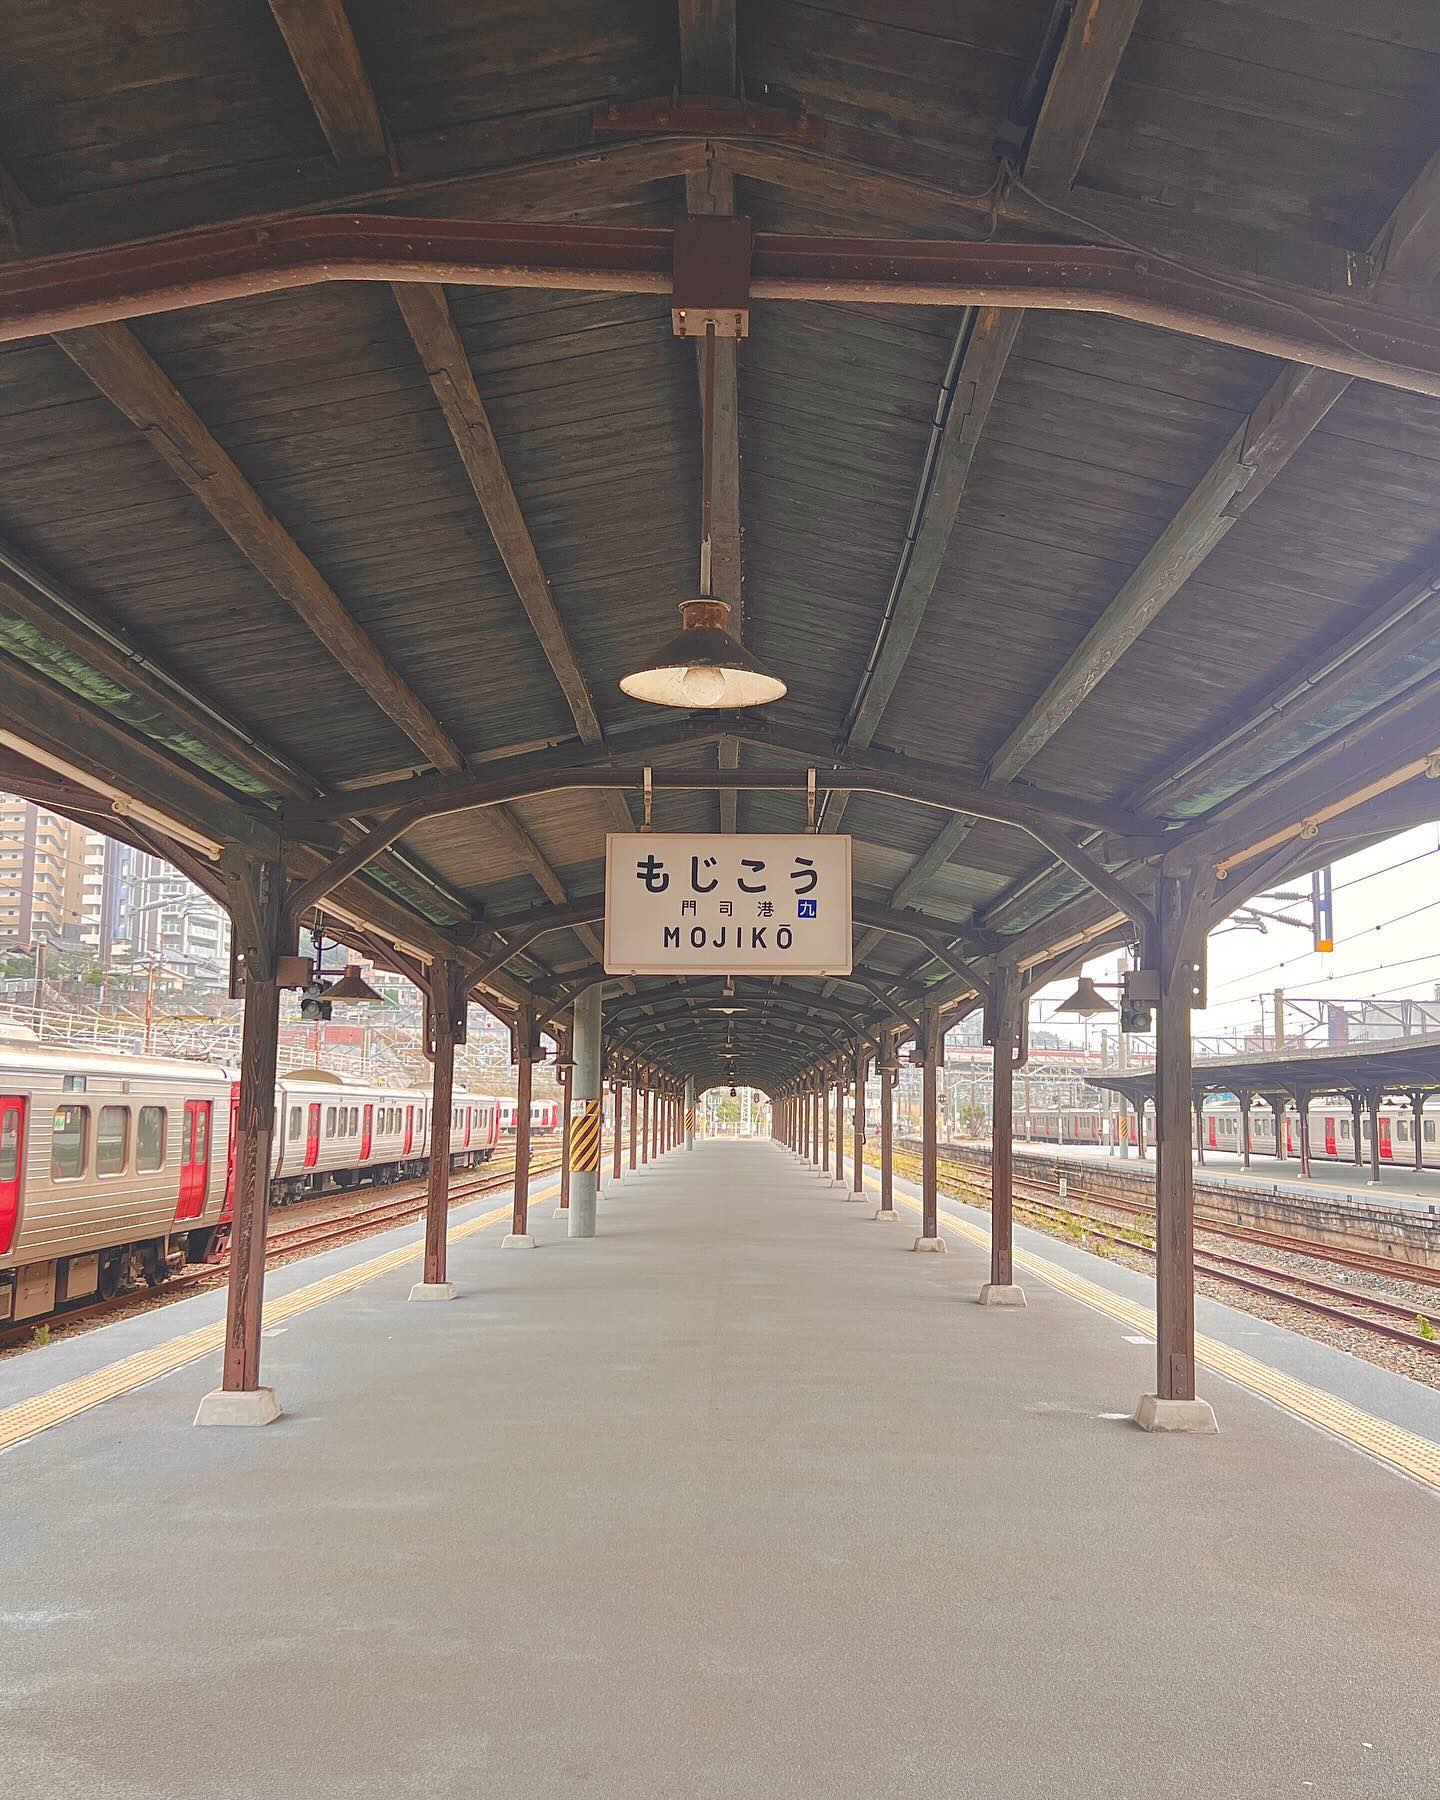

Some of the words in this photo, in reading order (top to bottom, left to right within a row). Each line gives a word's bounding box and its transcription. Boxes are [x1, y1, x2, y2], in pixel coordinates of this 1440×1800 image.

[636, 854, 818, 895] もじこう
[681, 900, 775, 918] 門司港
[799, 901, 816, 917] 九
[663, 924, 793, 950] MOJIKŌ
